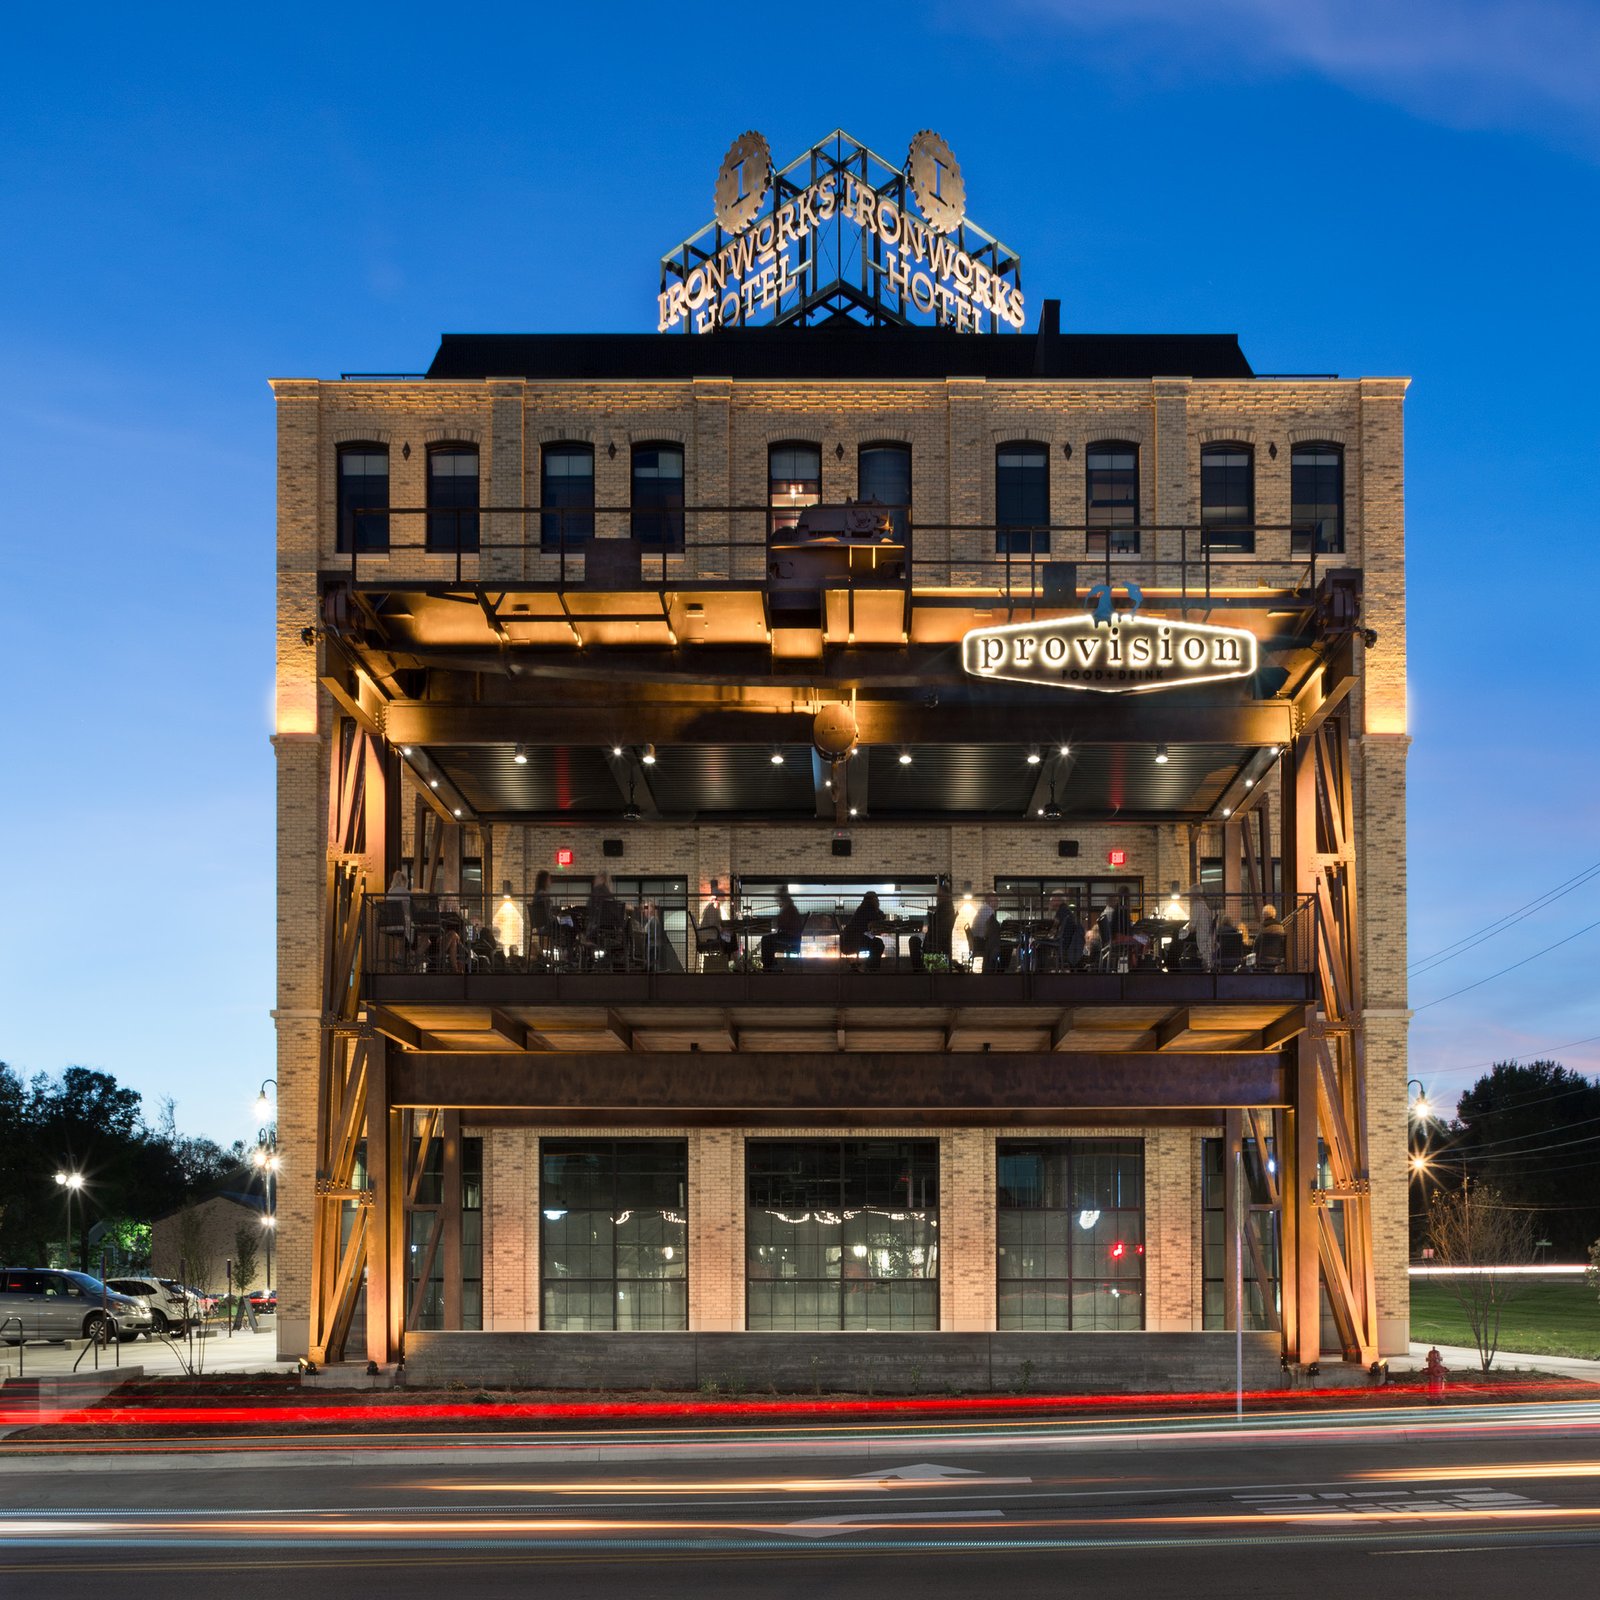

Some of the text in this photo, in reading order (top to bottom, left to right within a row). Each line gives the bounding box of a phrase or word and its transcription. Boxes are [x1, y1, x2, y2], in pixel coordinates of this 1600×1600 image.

[657, 173, 837, 333] IRONWORKS
[696, 255, 798, 334] HOTEL
[842, 172, 1025, 328] IRONWORKS
[981, 627, 1240, 668] provision
